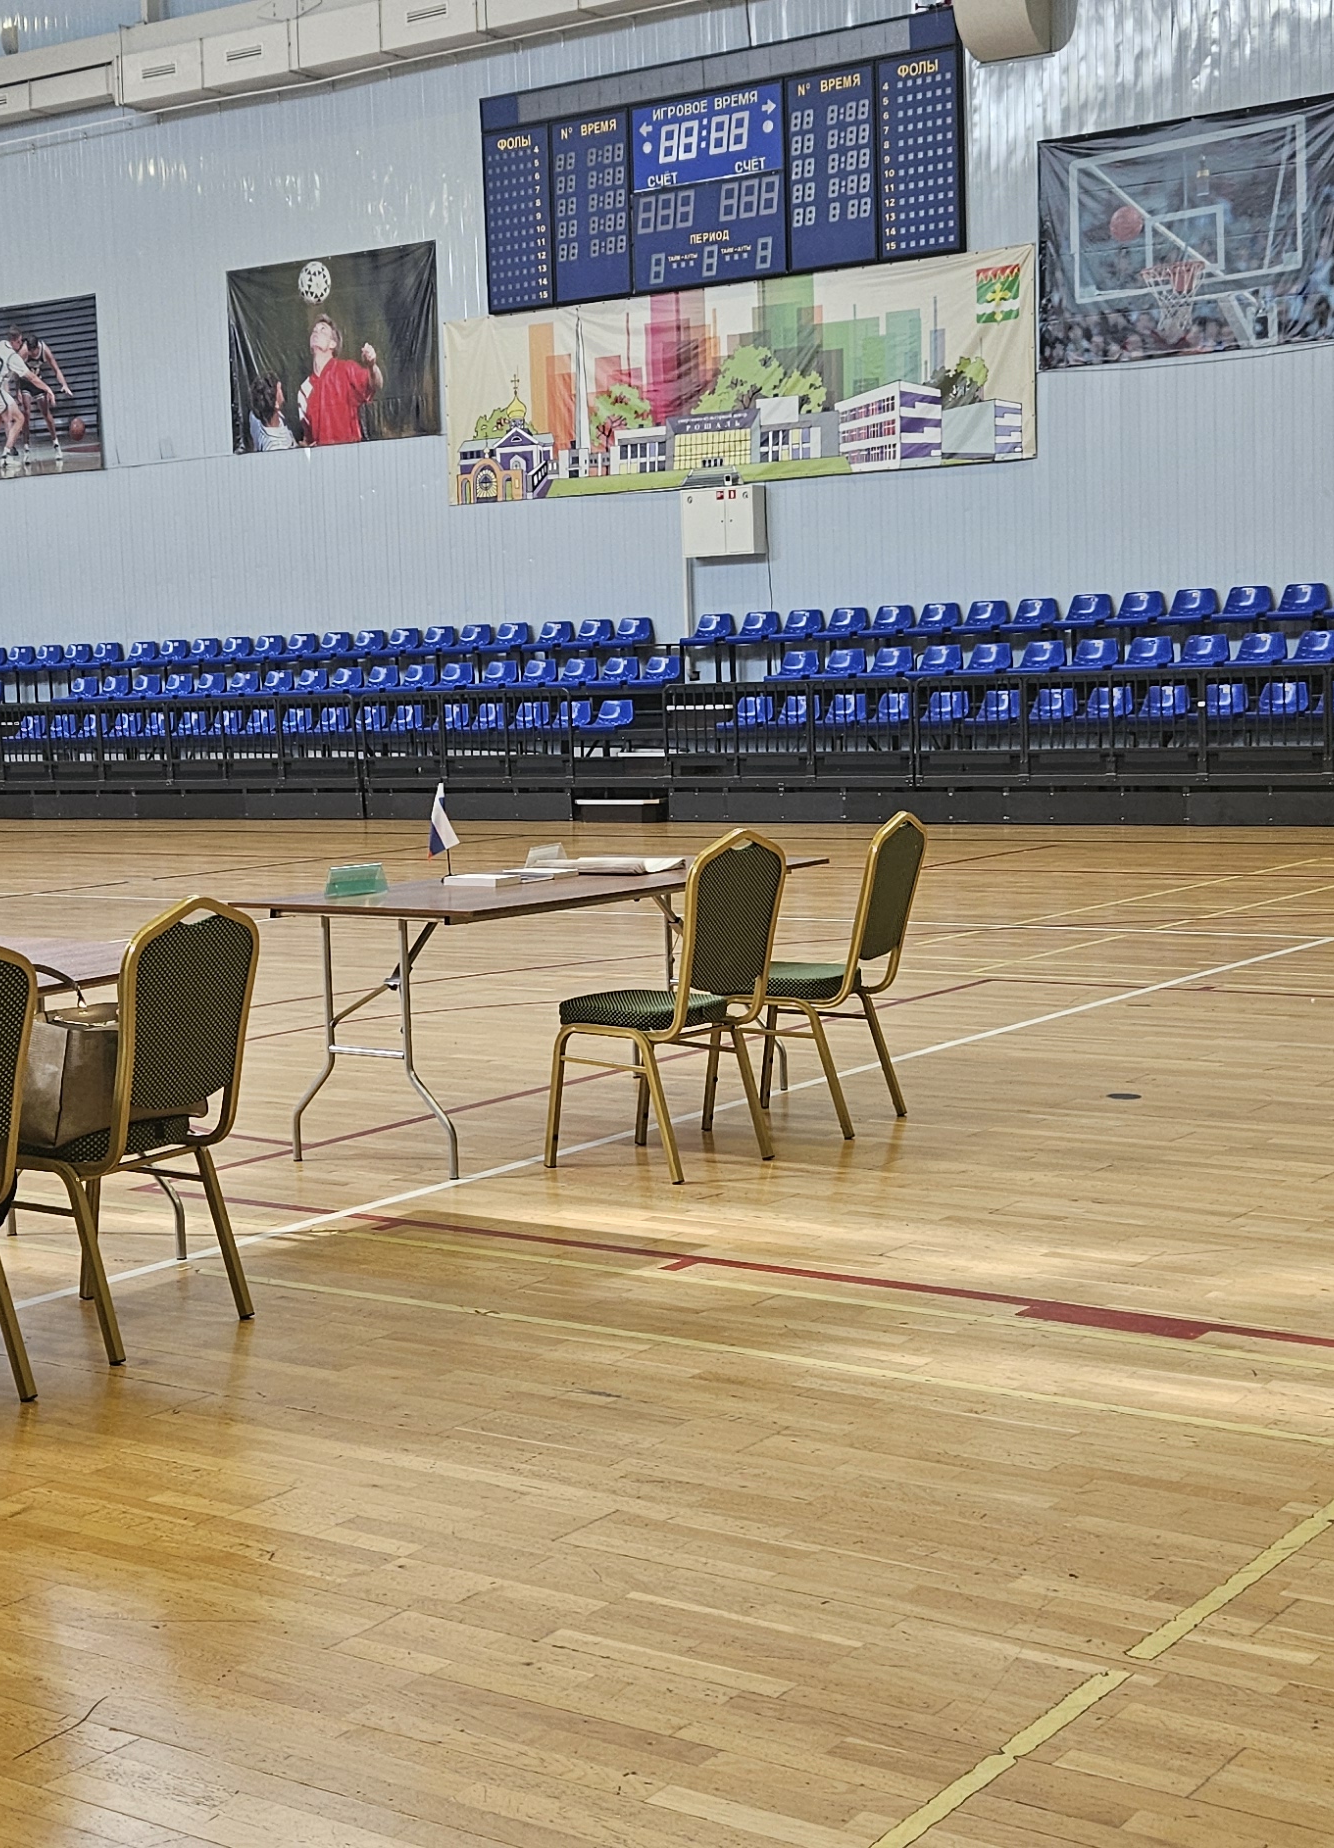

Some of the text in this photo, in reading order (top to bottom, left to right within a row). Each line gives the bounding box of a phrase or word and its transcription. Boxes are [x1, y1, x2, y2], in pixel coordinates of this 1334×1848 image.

[897, 59, 939, 78] ФОЛЫ
[820, 73, 861, 93] ВРЕМЯ
[882, 82, 889, 91] 4
[652, 90, 758, 121] ИГРОВОЕ ВРЕМЯ
[882, 97, 889, 105] 5
[883, 111, 889, 120] 6
[580, 119, 617, 136] ВРЕМЯ
[883, 126, 889, 135] 7
[497, 134, 531, 150] ФОЛЫ
[883, 140, 890, 149] 8
[533, 146, 539, 154] 4
[534, 159, 539, 167] 5
[884, 155, 890, 164] 9
[735, 156, 766, 173] СЧЁТ
[534, 172, 540, 180] 6
[884, 169, 895, 178] 10
[647, 170, 678, 187] СЧЁТ
[884, 184, 895, 192] 11
[535, 199, 541, 207] 8
[884, 199, 896, 207] 12
[536, 212, 541, 220] 9
[885, 213, 896, 222] 13
[536, 225, 546, 233] 10
[885, 228, 896, 237] 14
[537, 238, 546, 246] 11
[689, 230, 730, 245] ПЕРИОД
[885, 242, 897, 251] 15
[538, 278, 548, 286] 14
[539, 291, 548, 299] 15
[686, 420, 741, 432] РОШАЛЬ
